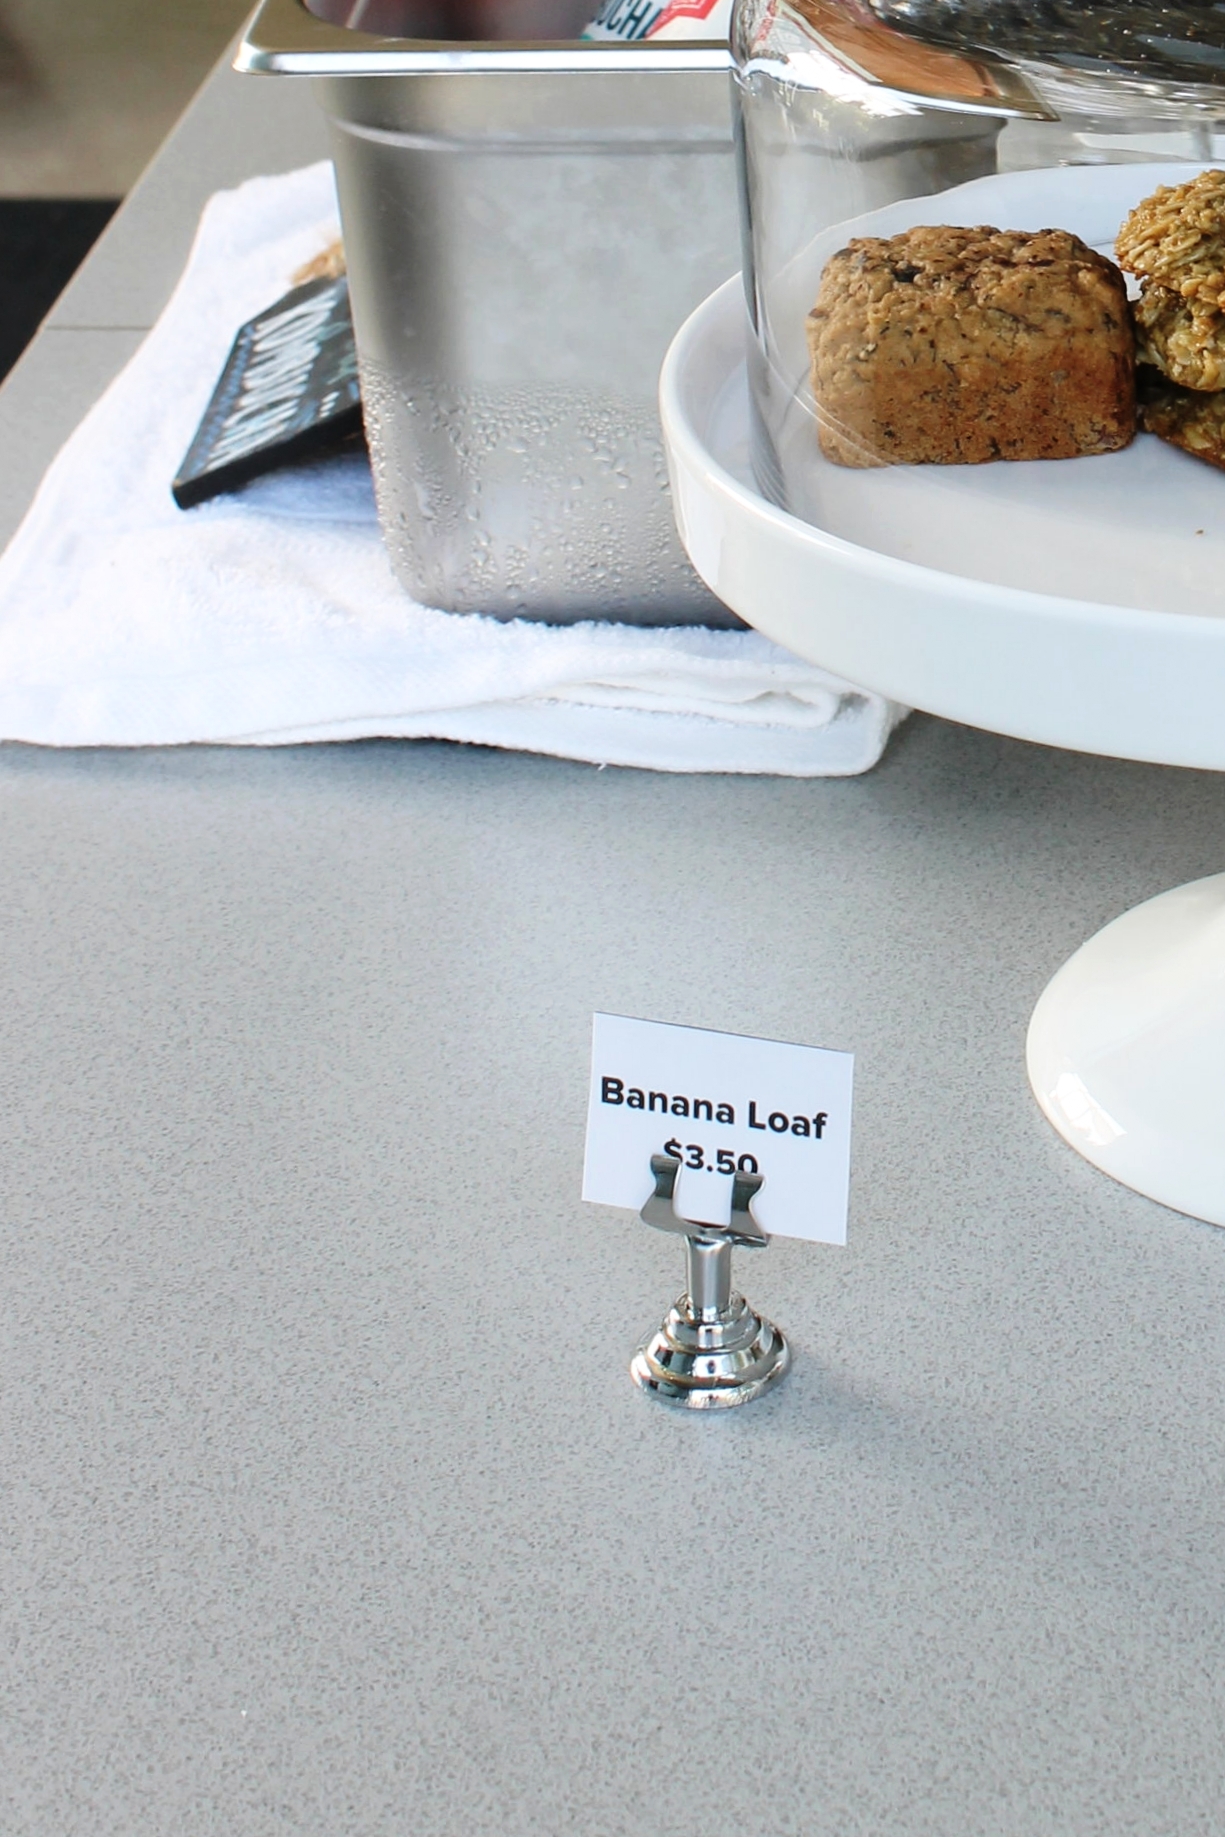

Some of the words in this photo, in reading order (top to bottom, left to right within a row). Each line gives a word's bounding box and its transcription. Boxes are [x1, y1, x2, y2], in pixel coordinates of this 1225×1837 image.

[601, 1076, 735, 1125] Banana
[748, 1100, 828, 1139] Loaf
[663, 1137, 759, 1176] $3.50
